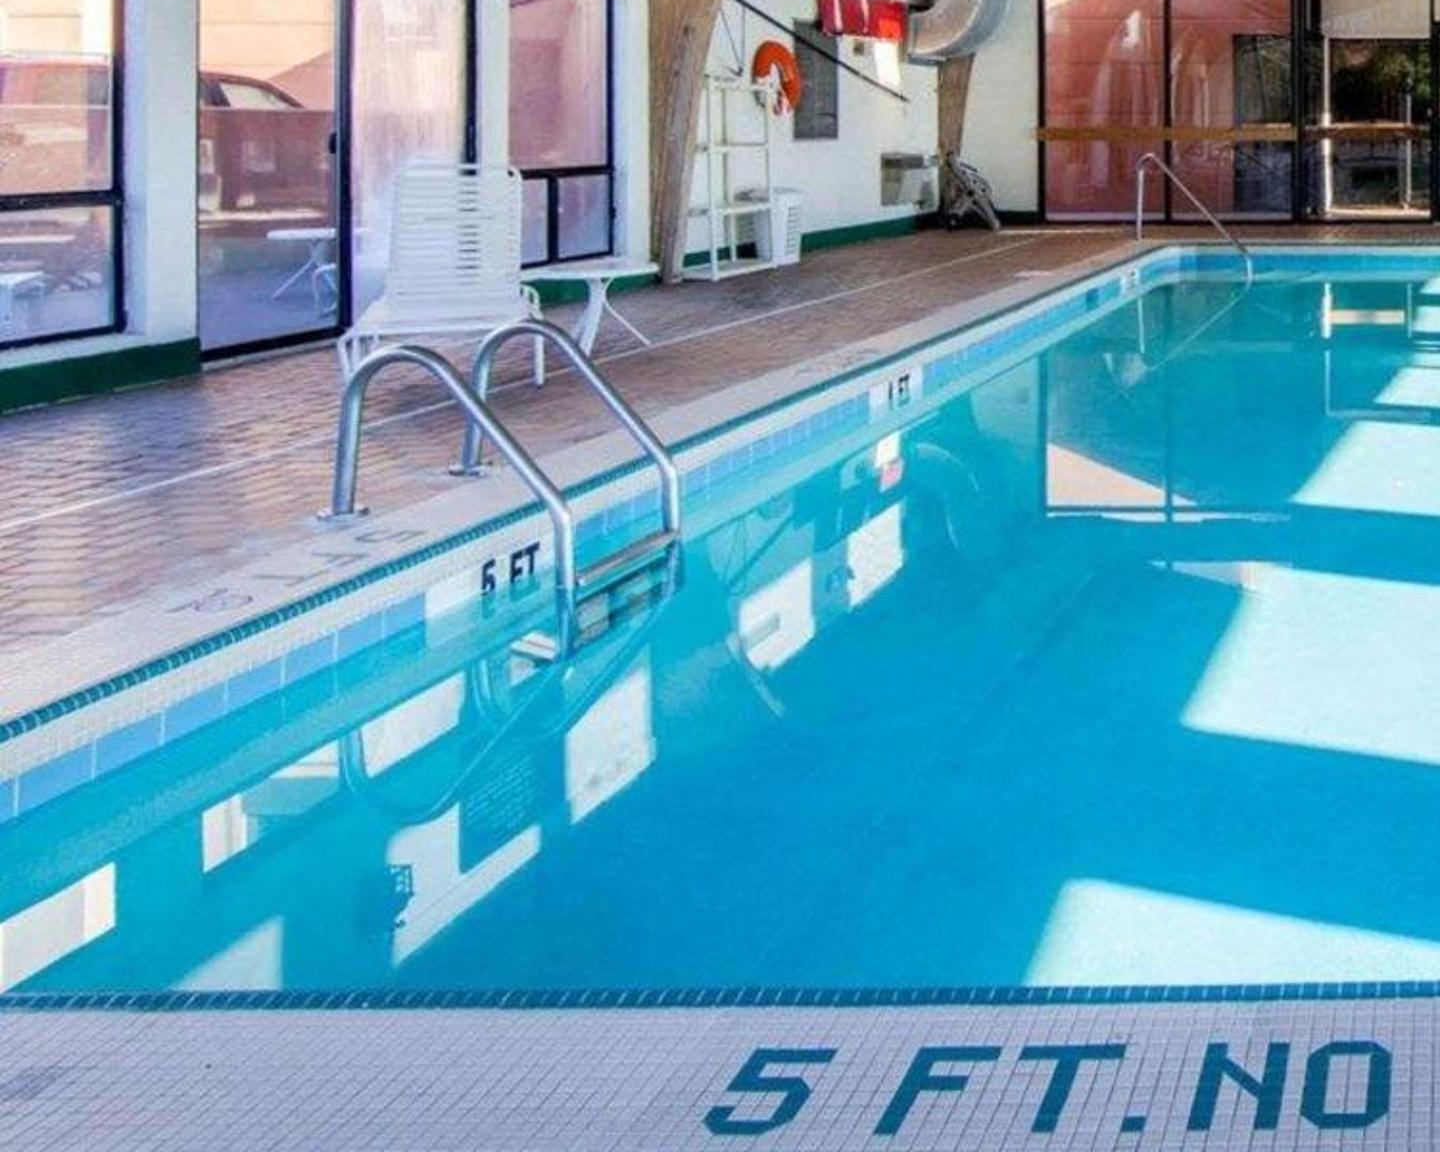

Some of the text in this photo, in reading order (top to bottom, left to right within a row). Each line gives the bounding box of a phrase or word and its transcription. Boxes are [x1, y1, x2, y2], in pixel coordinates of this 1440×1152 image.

[510, 540, 540, 585] FT
[703, 1047, 838, 1136] 5
[1187, 1041, 1392, 1132] NO
